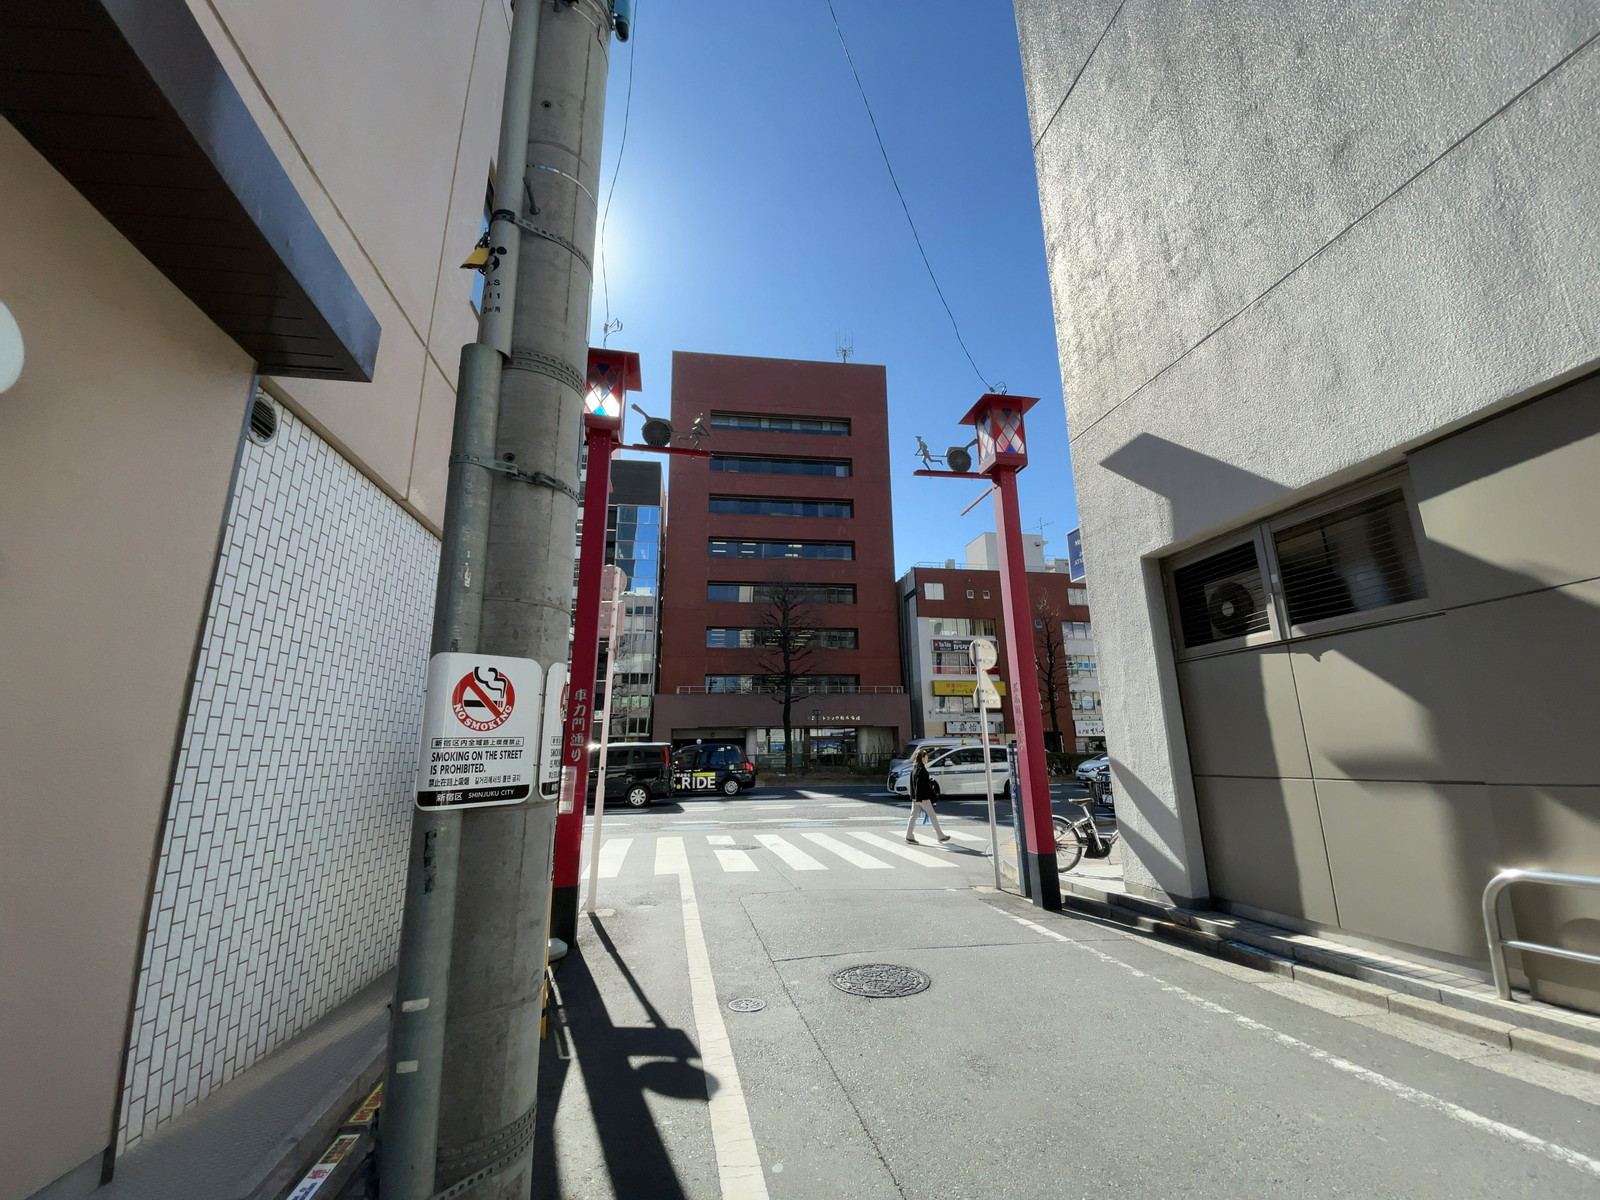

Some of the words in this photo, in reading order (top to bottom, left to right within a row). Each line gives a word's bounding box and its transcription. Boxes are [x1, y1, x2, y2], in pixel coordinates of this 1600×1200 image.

[453, 703, 467, 720] NO
[465, 705, 513, 731] SMOKING
[569, 688, 588, 762] 車力門通り
[431, 751, 470, 763] SMOKING
[471, 751, 483, 761] ON
[485, 750, 498, 760] THE
[499, 749, 524, 760] STREET
[430, 764, 438, 775] IS
[439, 763, 486, 775] PROHIBITED.
[436, 792, 463, 803] 新宿区
[468, 790, 500, 799] SHINJUKU
[500, 788, 515, 796] CITY
